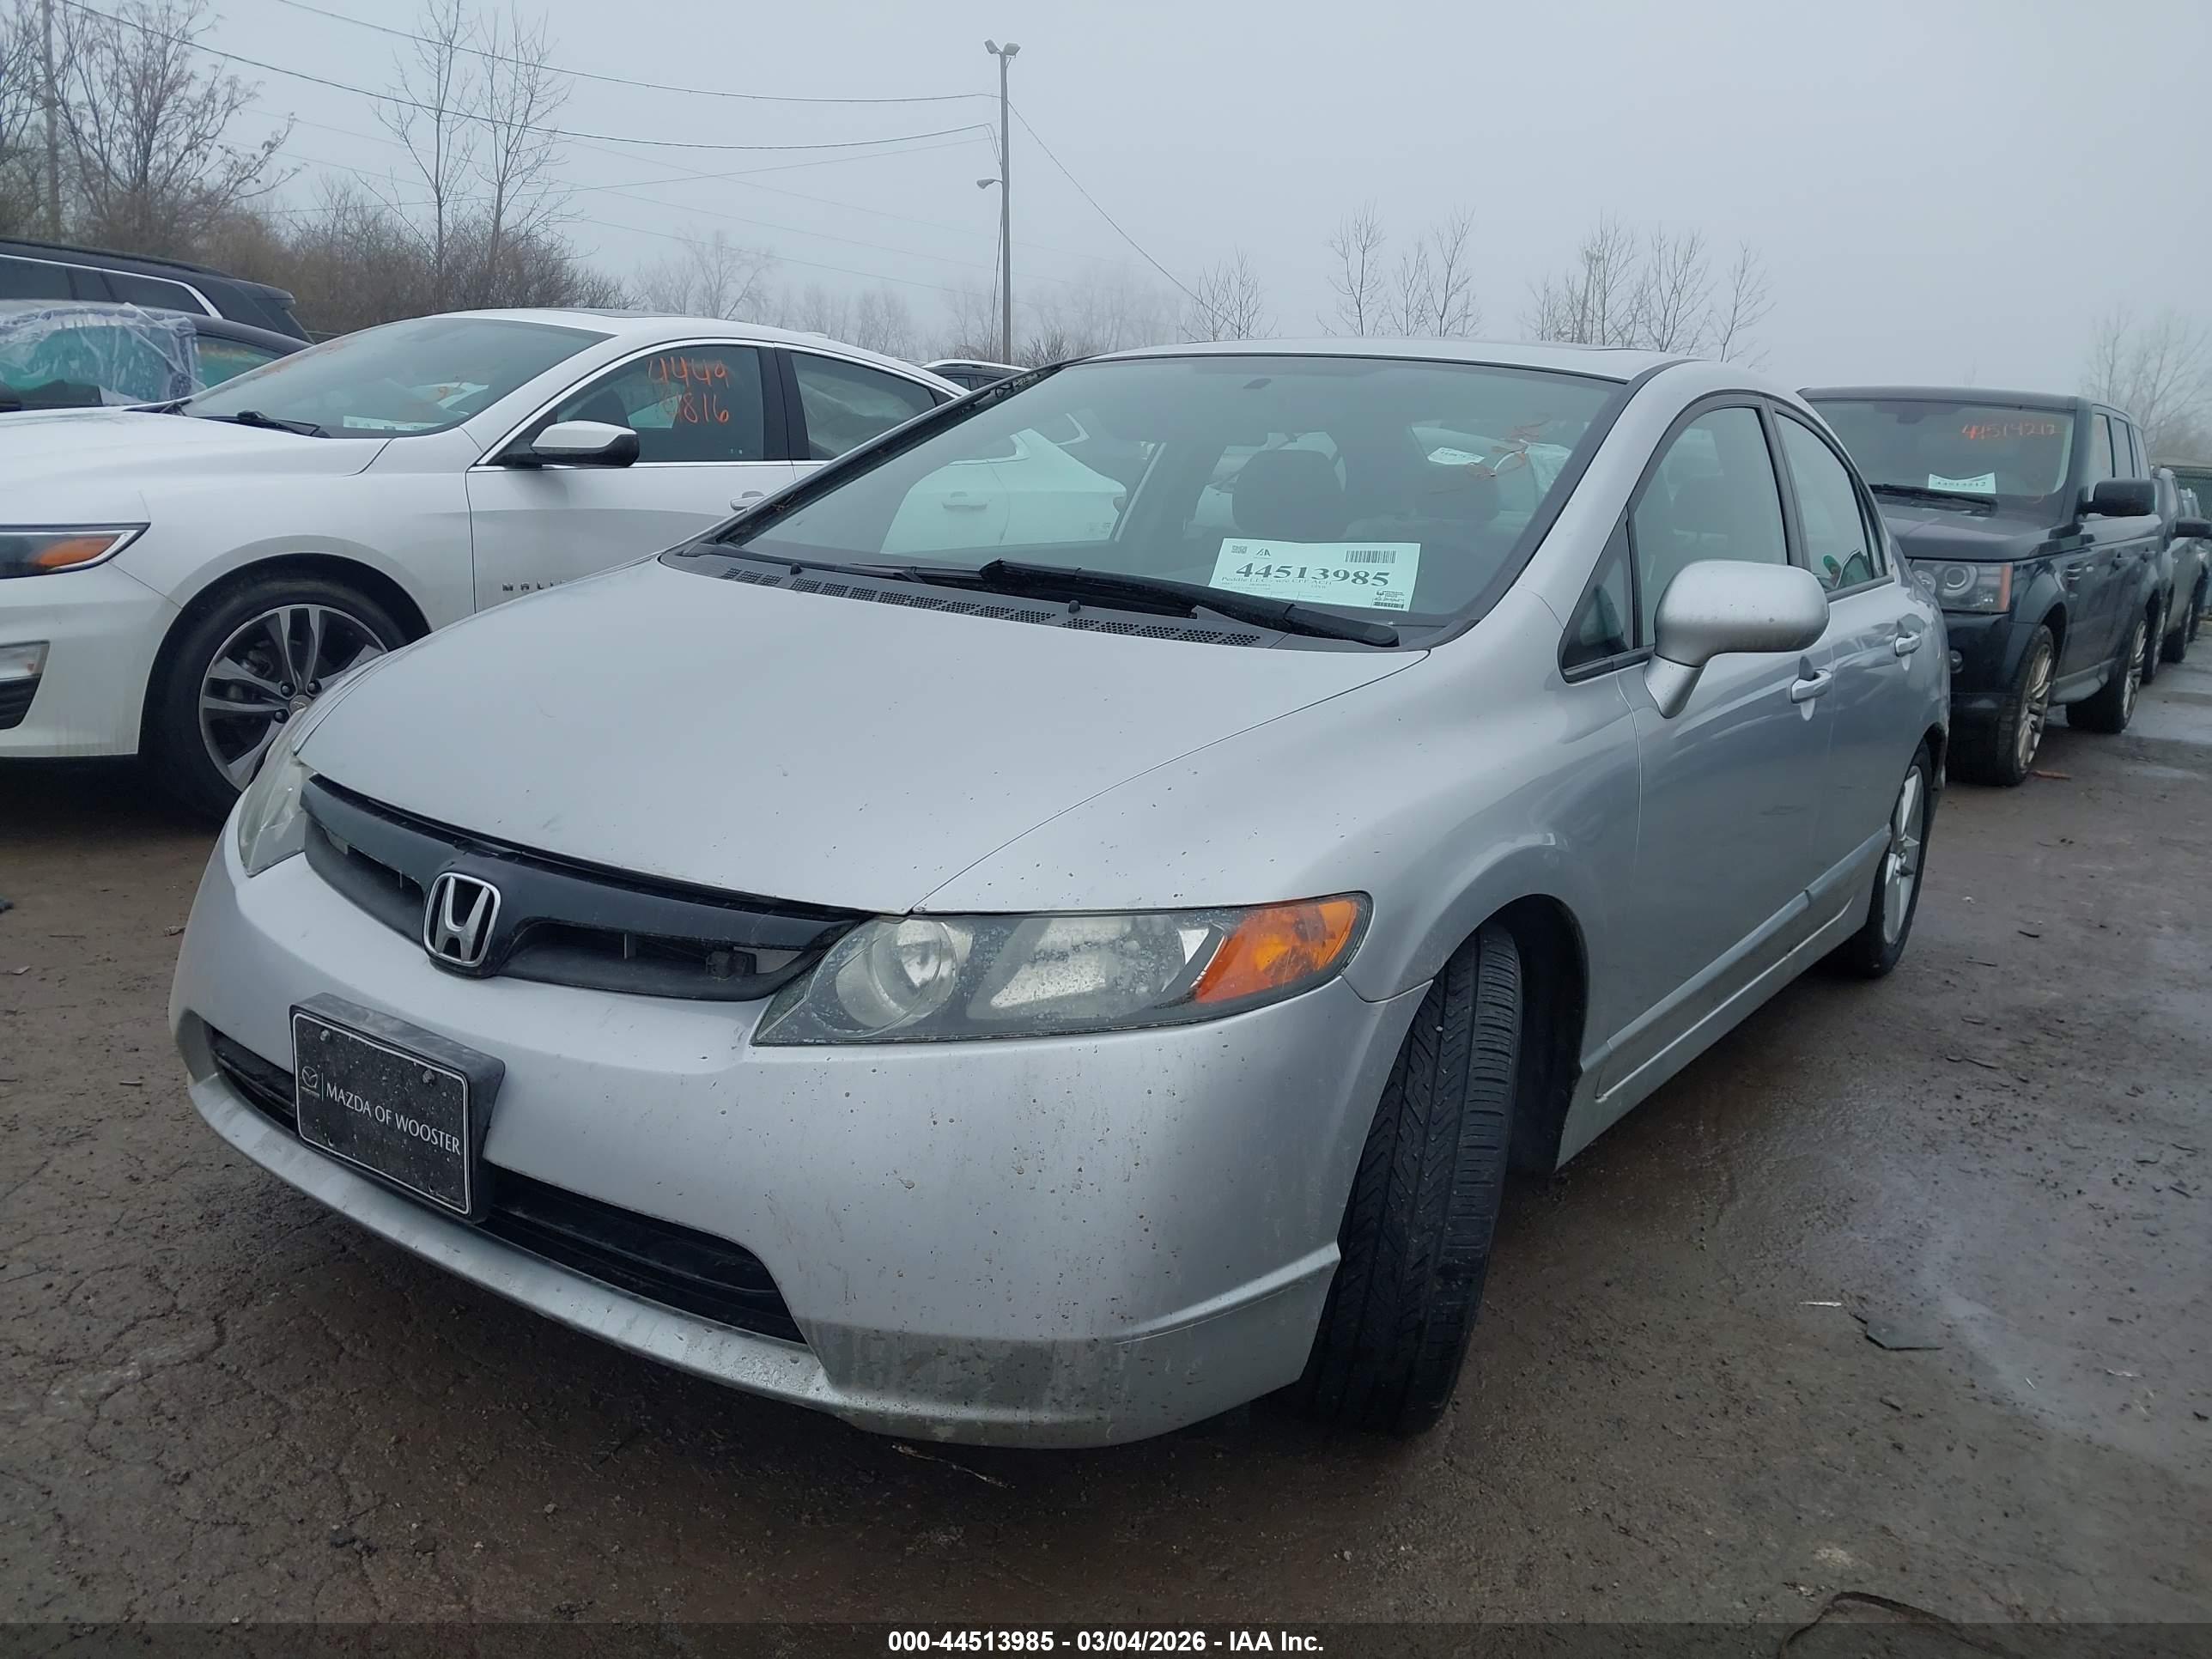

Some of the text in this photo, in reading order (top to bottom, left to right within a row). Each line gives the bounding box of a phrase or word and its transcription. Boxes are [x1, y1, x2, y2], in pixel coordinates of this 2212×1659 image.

[1236, 562, 1390, 586] 44513985
[326, 1082, 461, 1156] MAZDA OF WOOSTER
